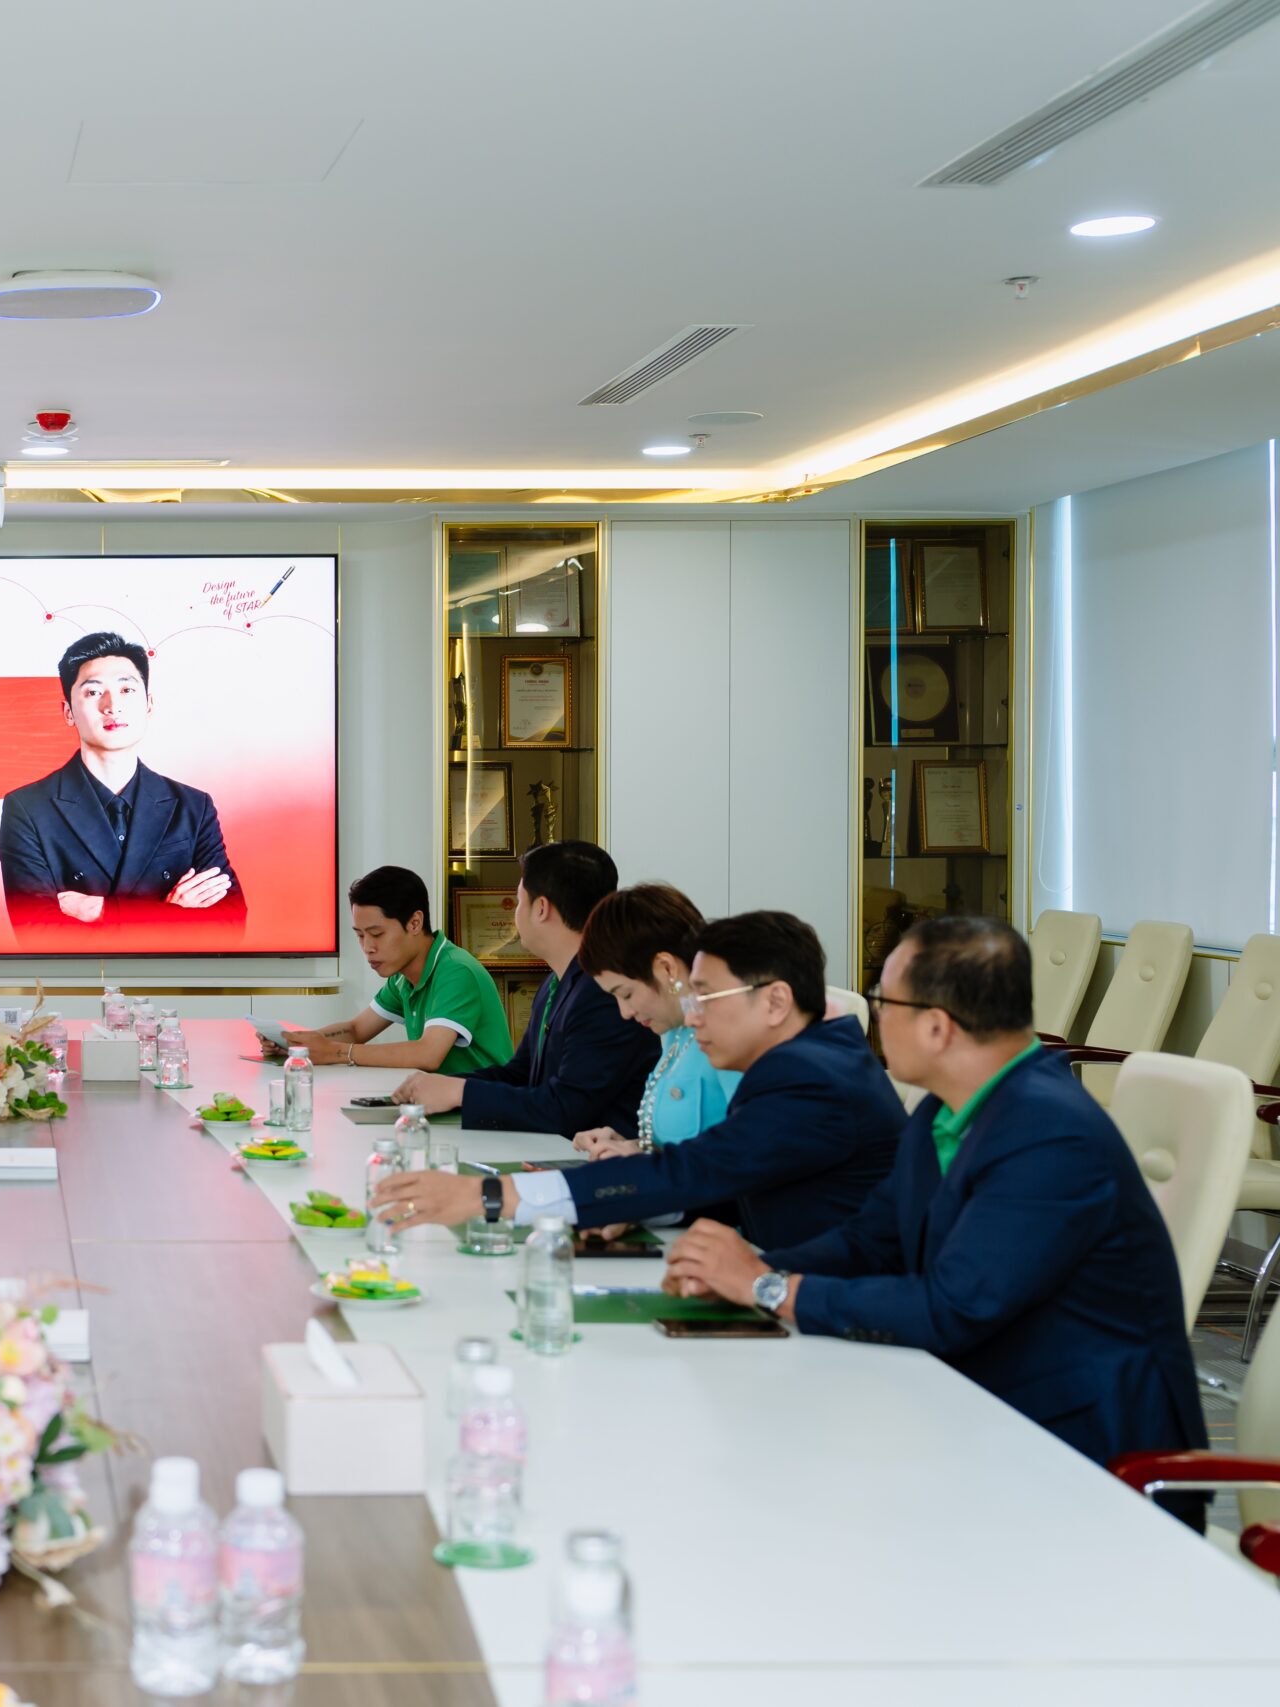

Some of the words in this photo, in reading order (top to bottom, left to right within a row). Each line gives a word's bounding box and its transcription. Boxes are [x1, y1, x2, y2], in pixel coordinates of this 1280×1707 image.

[202, 580, 236, 594] Design
[210, 594, 224, 606] the
[225, 590, 256, 607] future
[222, 607, 232, 620] of
[235, 600, 262, 614] STAR
